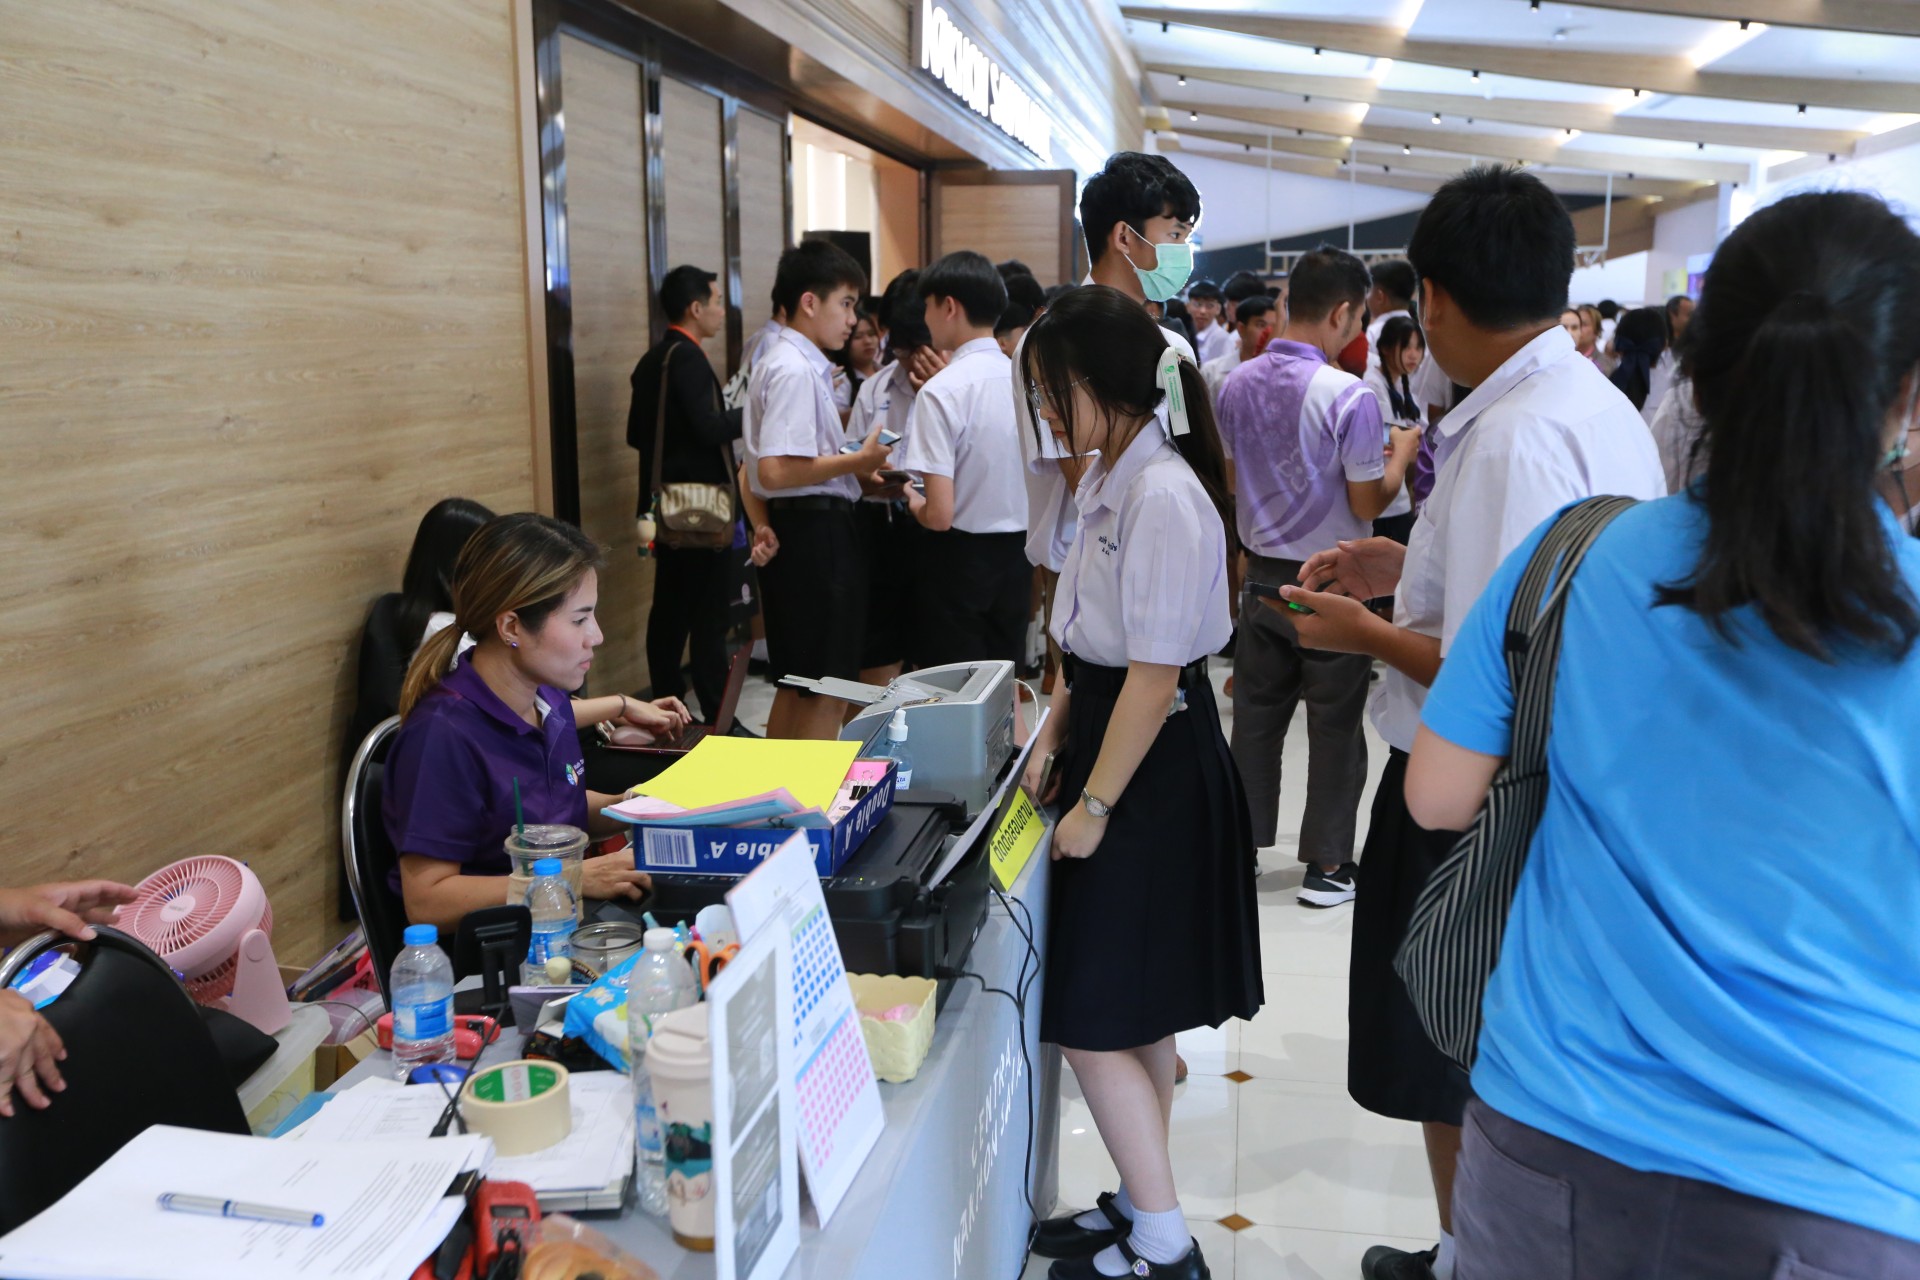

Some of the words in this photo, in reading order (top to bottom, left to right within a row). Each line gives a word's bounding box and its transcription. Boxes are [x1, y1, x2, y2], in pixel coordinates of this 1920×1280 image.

[856, 780, 891, 832] Double
[710, 841, 728, 859] A
[845, 818, 854, 850] A
[735, 842, 820, 861] Dble
[953, 1119, 997, 1280] NAKHON
